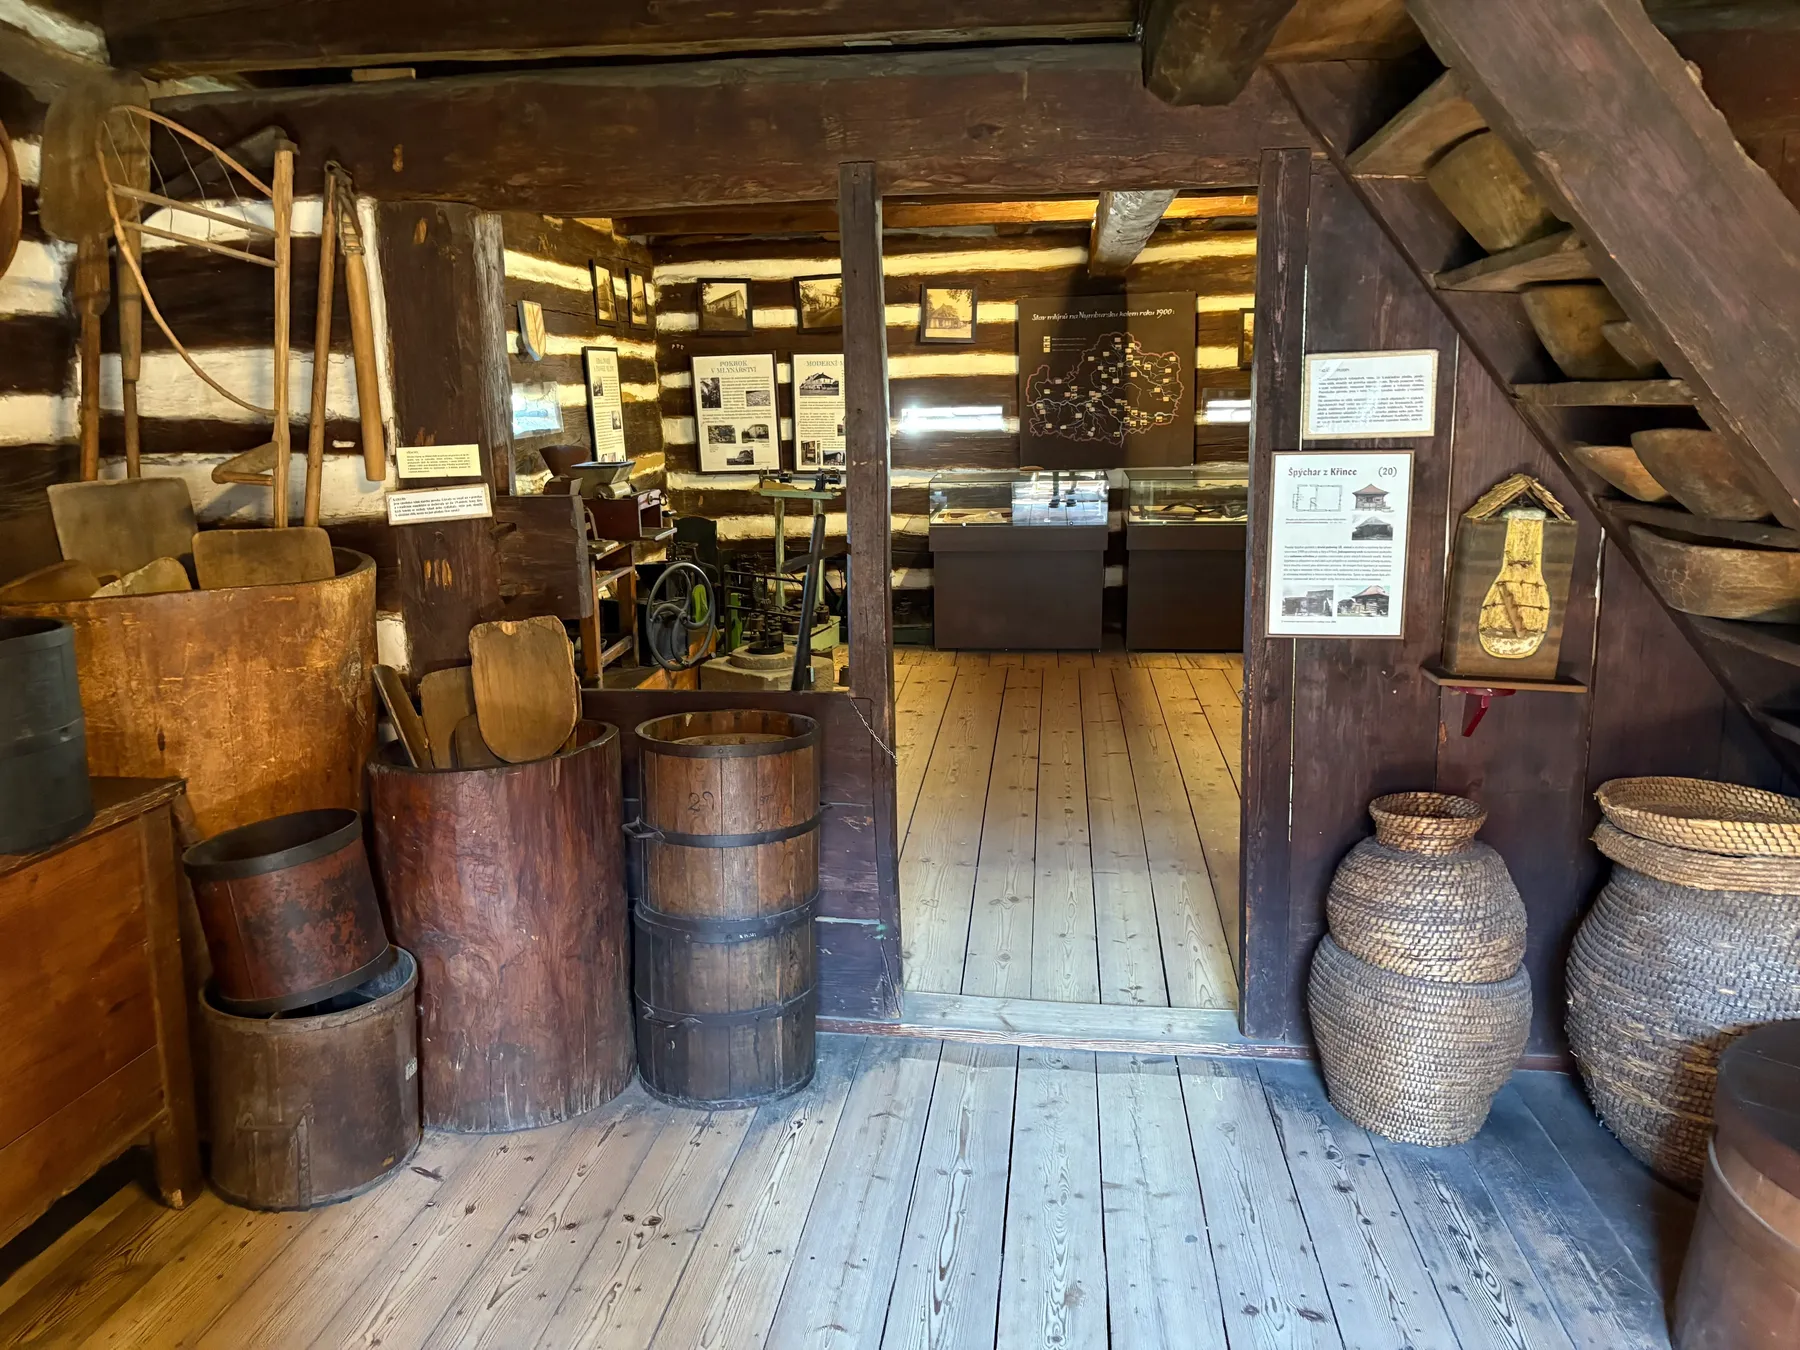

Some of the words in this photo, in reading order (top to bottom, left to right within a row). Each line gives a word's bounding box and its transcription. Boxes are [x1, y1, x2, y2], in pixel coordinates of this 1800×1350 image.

[1118, 310, 1139, 318] kolem
[719, 360, 748, 368] POKROK
[1288, 467, 1321, 478] Špýchar
[1330, 467, 1358, 476] Křince
[1378, 466, 1398, 478] (20)
